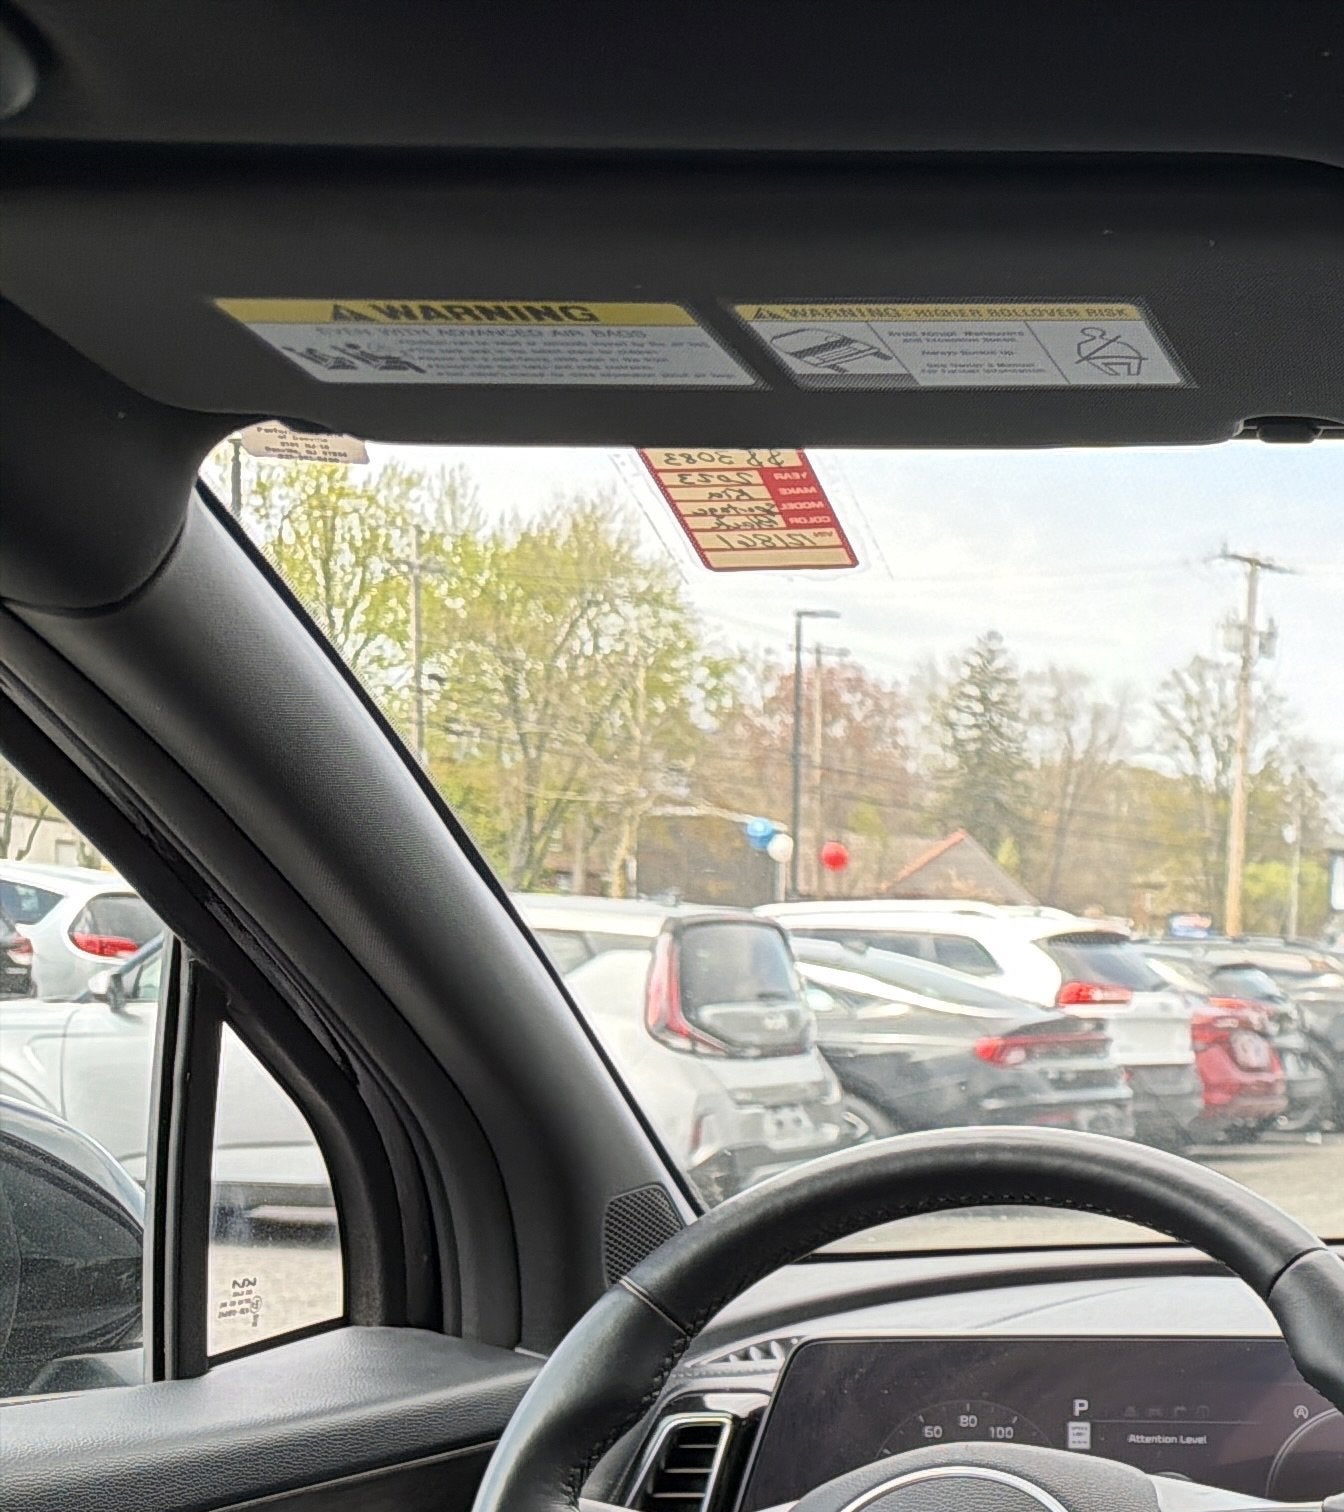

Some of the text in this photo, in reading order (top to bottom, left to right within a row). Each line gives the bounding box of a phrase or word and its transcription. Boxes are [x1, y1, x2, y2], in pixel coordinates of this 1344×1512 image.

[368, 303, 600, 322] WARNING
[1072, 1398, 1089, 1417] P
[958, 1414, 978, 1428] 80
[989, 1426, 1014, 1439] 100
[1127, 1433, 1208, 1444] Attention Level
